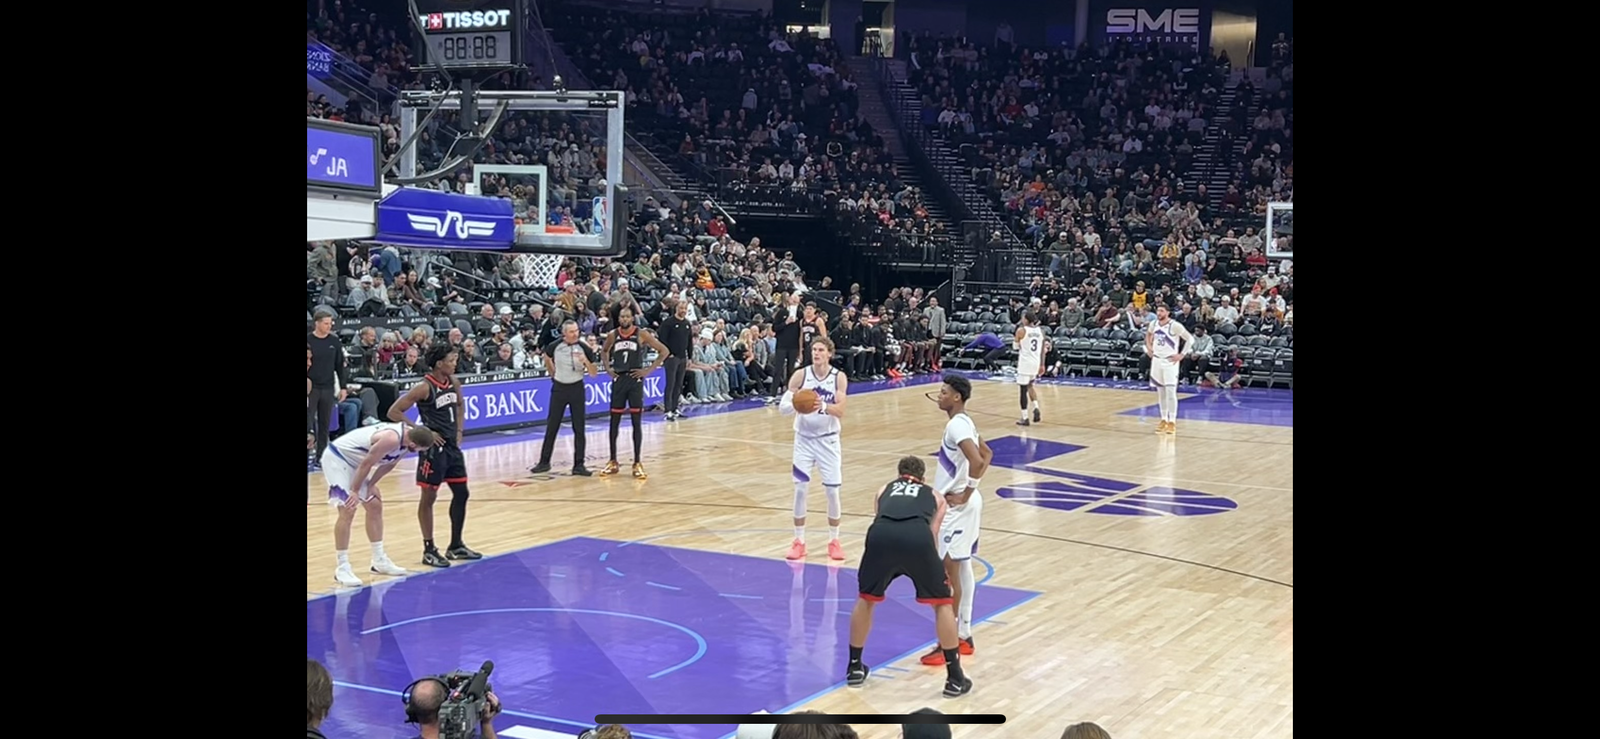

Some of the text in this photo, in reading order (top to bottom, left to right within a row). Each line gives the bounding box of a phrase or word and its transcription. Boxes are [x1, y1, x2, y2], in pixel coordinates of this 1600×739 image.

[443, 10, 510, 28] TISSOT
[1107, 9, 1199, 33] SME
[327, 157, 348, 177] JA
[1030, 338, 1038, 352] 3
[622, 351, 629, 364] 7
[470, 375, 487, 383] DELTA
[524, 370, 540, 378] DELTA
[585, 376, 665, 405] ONS NK
[449, 406, 455, 423] 1
